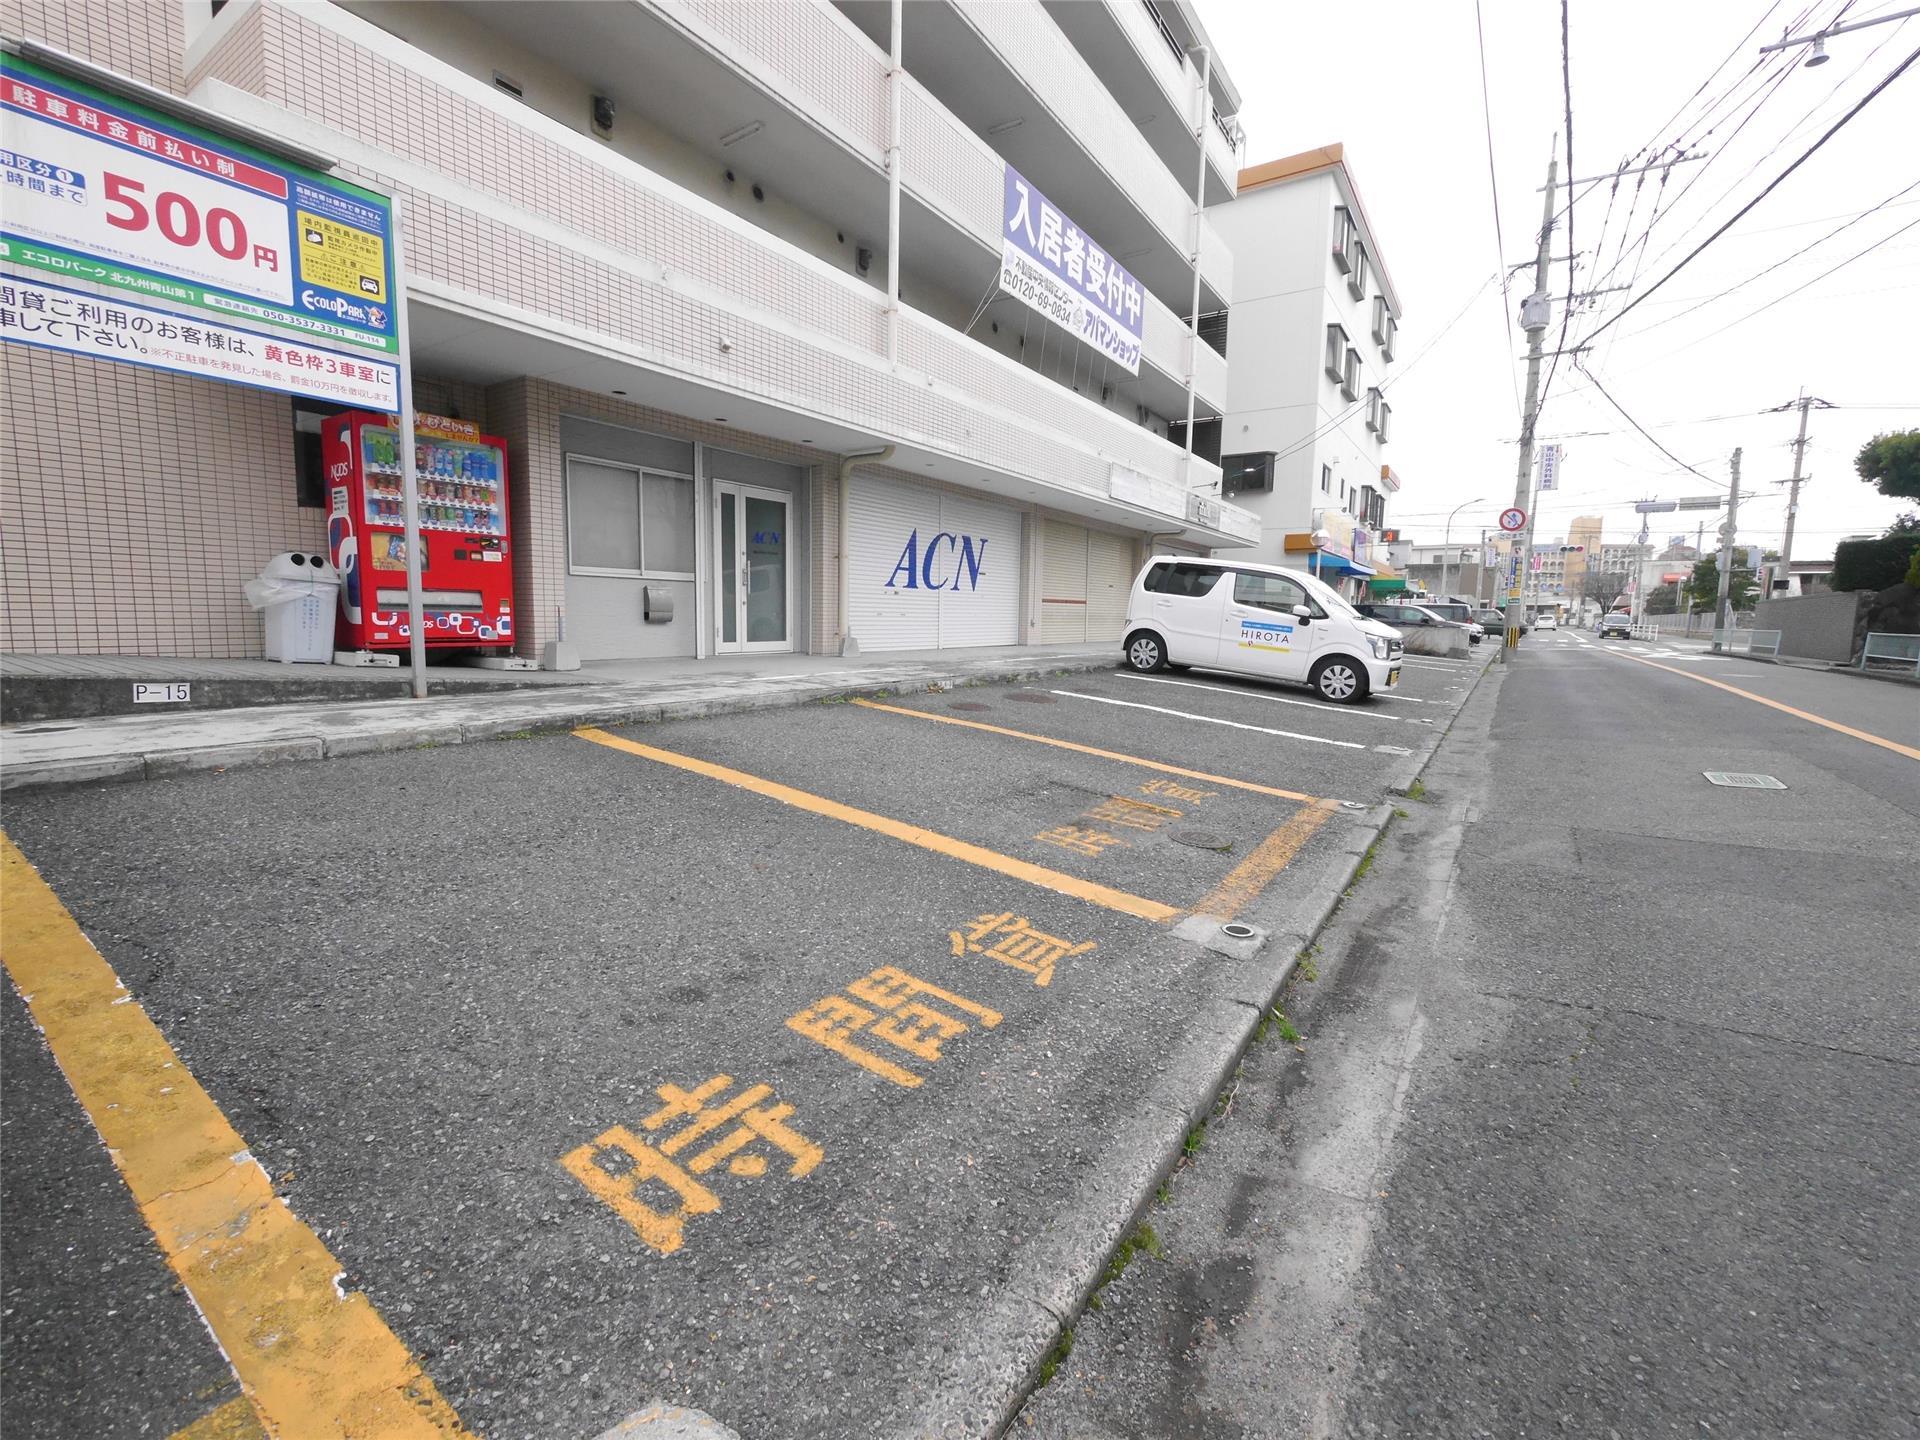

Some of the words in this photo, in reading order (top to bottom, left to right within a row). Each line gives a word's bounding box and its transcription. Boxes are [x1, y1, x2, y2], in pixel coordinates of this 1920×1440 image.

[12, 85, 236, 178] 駐車料金前払い制
[0, 170, 83, 204] 時間まで
[22, 250, 107, 277] エコロパーク
[1009, 180, 1141, 326] 入居者受付中
[1011, 274, 1071, 325] 0120-69-0834
[263, 309, 346, 336] 050-3537-3331
[1083, 308, 1141, 367] アパマンショップ
[751, 530, 782, 545] ACN
[884, 528, 989, 592] ACN
[1241, 629, 1290, 644] HIROTA
[136, 684, 187, 701] P-15
